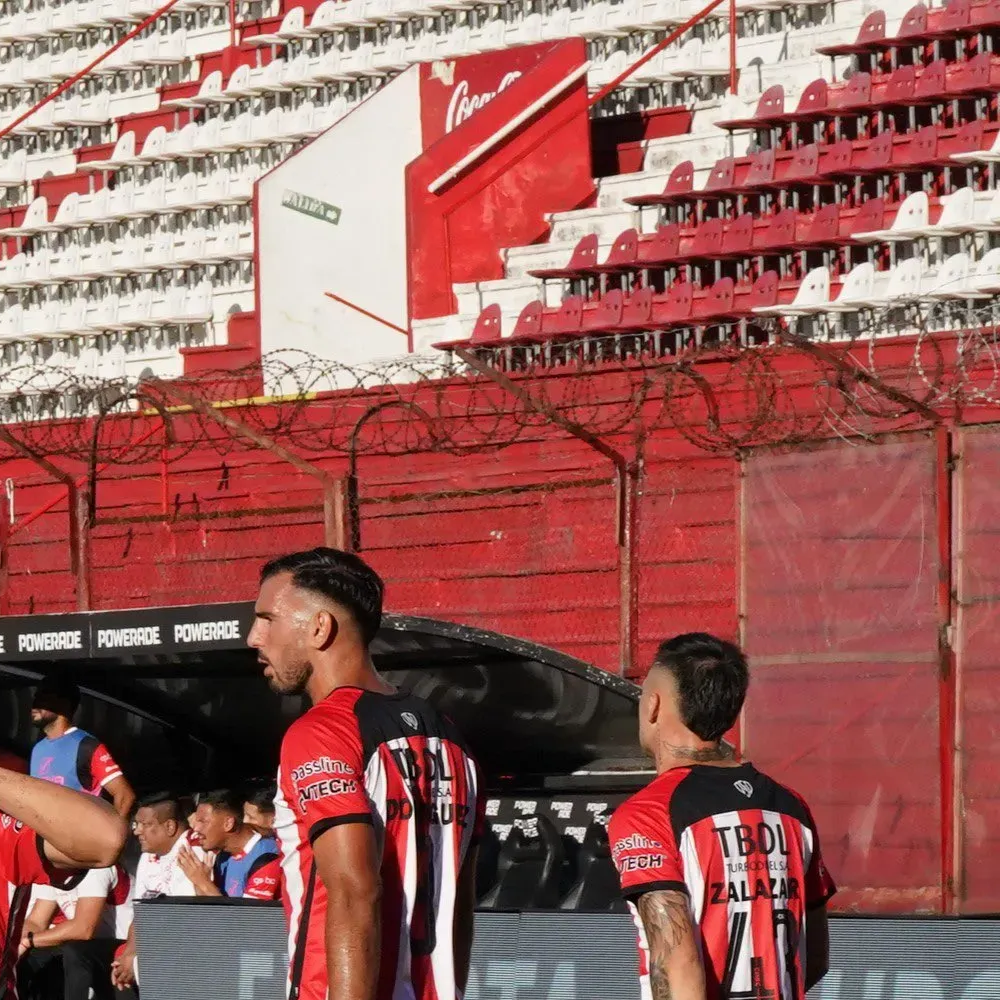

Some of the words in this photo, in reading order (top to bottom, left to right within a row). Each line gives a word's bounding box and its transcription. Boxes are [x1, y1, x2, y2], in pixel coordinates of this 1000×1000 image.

[19, 631, 82, 652] POWERADE
[98, 626, 161, 647] POWERADE
[174, 620, 240, 643] POWERADE
[711, 822, 792, 859] TBDL
[711, 877, 799, 904] ZALAZAR
